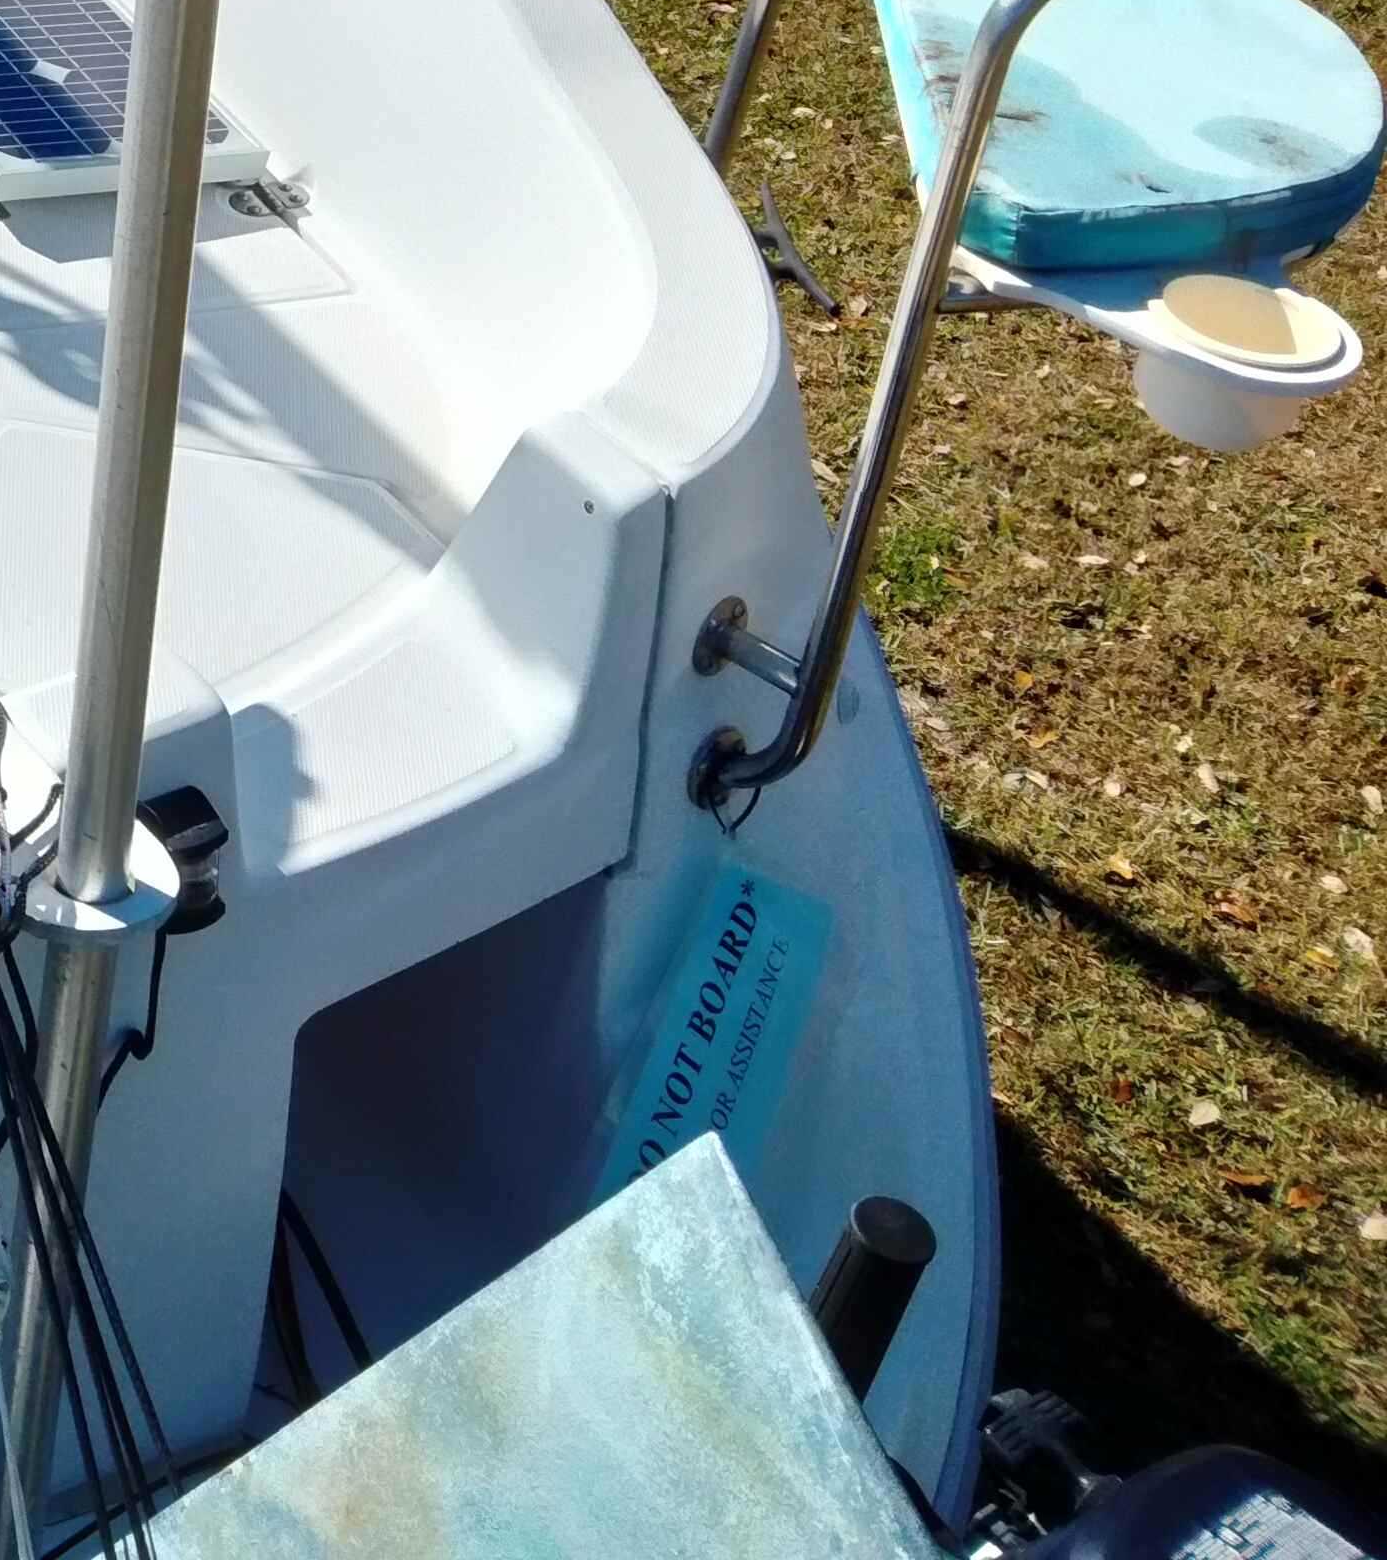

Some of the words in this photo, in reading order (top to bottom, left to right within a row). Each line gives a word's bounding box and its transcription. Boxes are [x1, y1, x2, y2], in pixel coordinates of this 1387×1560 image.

[728, 936, 789, 1091] ASSISTANCE
[627, 1139, 667, 1186] O
[650, 1042, 703, 1138] NOT
